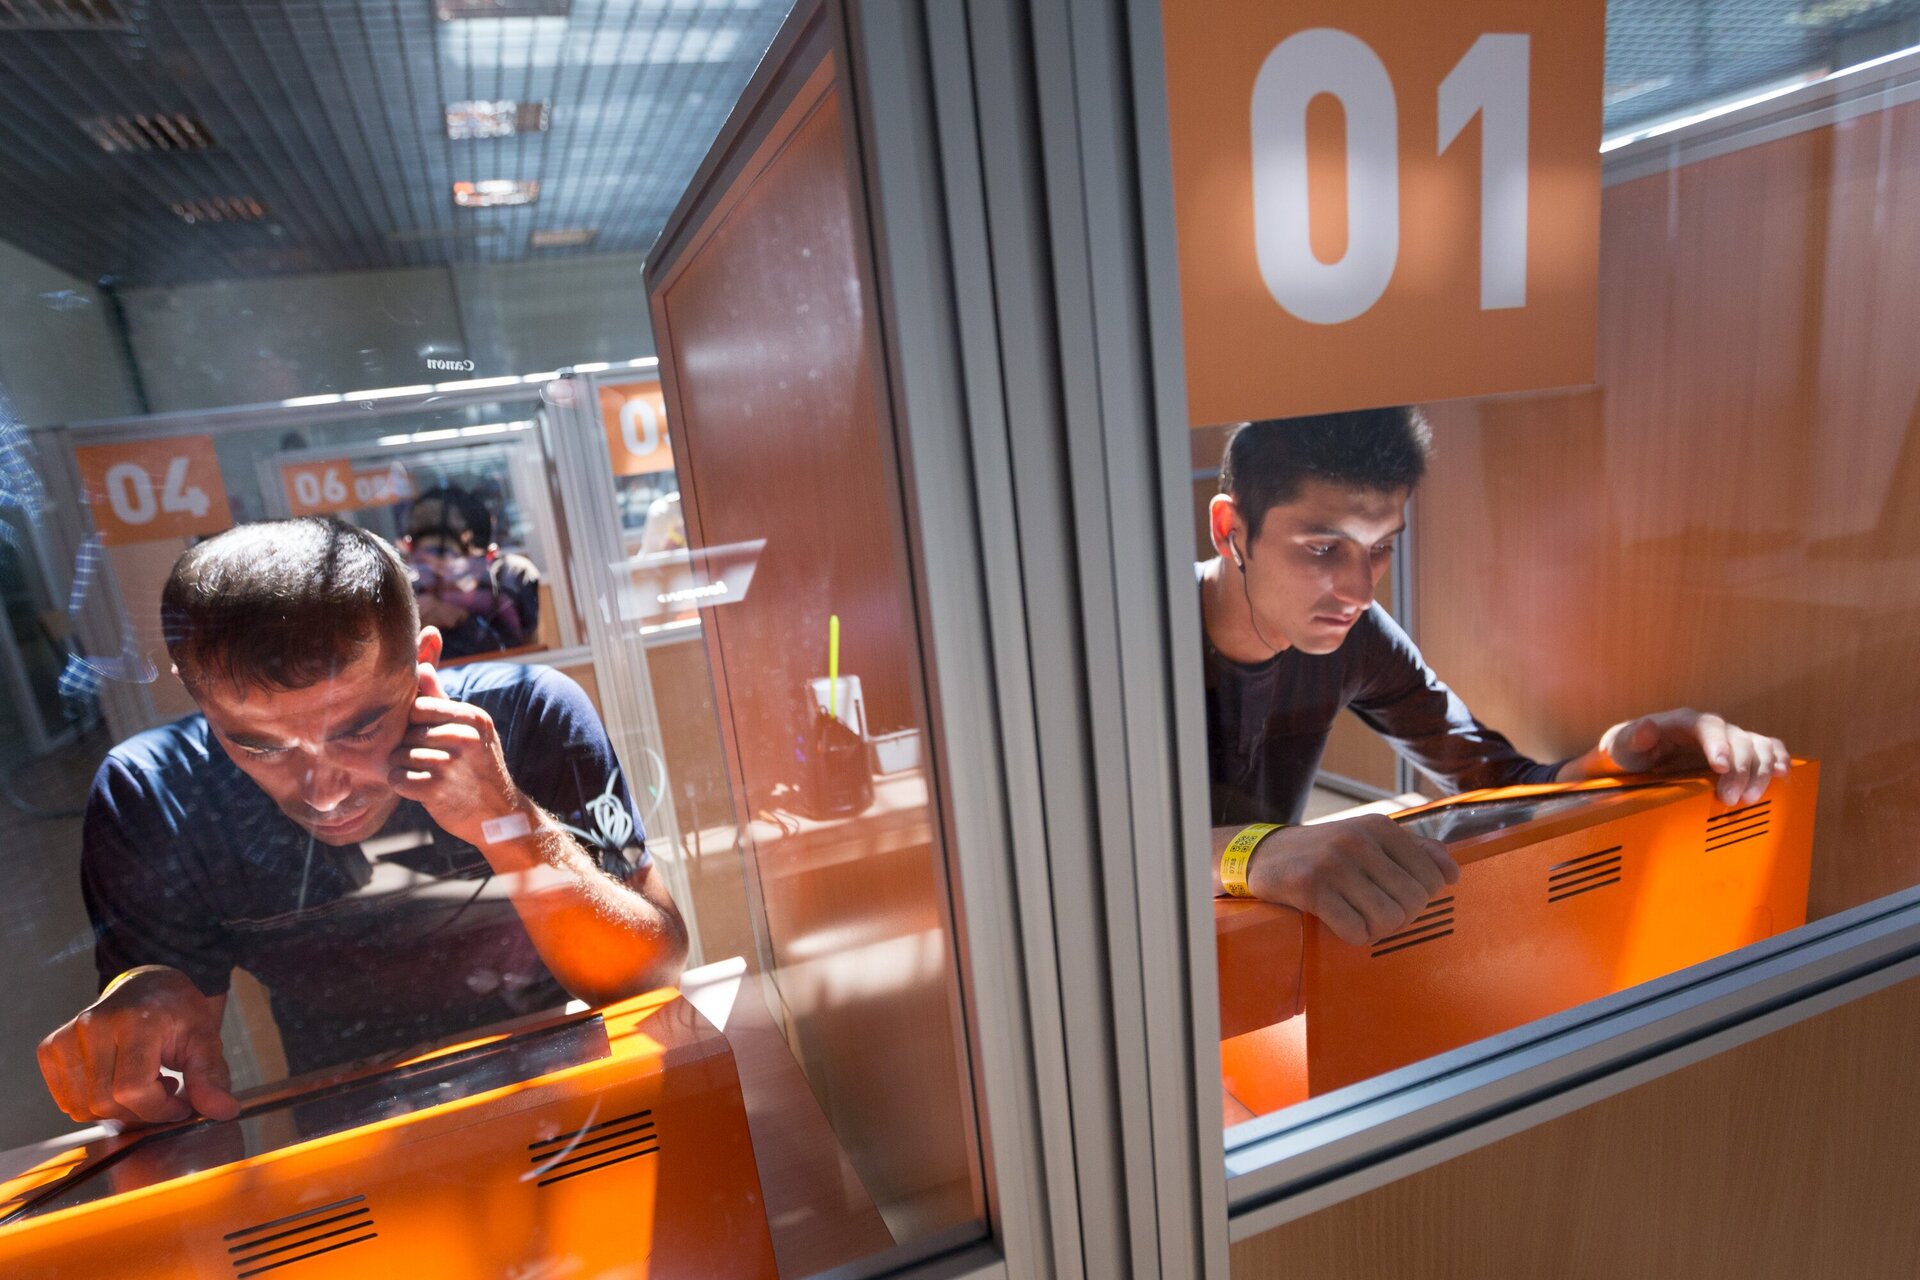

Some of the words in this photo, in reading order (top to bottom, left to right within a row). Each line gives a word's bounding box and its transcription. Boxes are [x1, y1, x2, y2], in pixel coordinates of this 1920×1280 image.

[1250, 27, 1530, 324] 01
[106, 456, 209, 525] 04
[293, 467, 348, 506] 06
